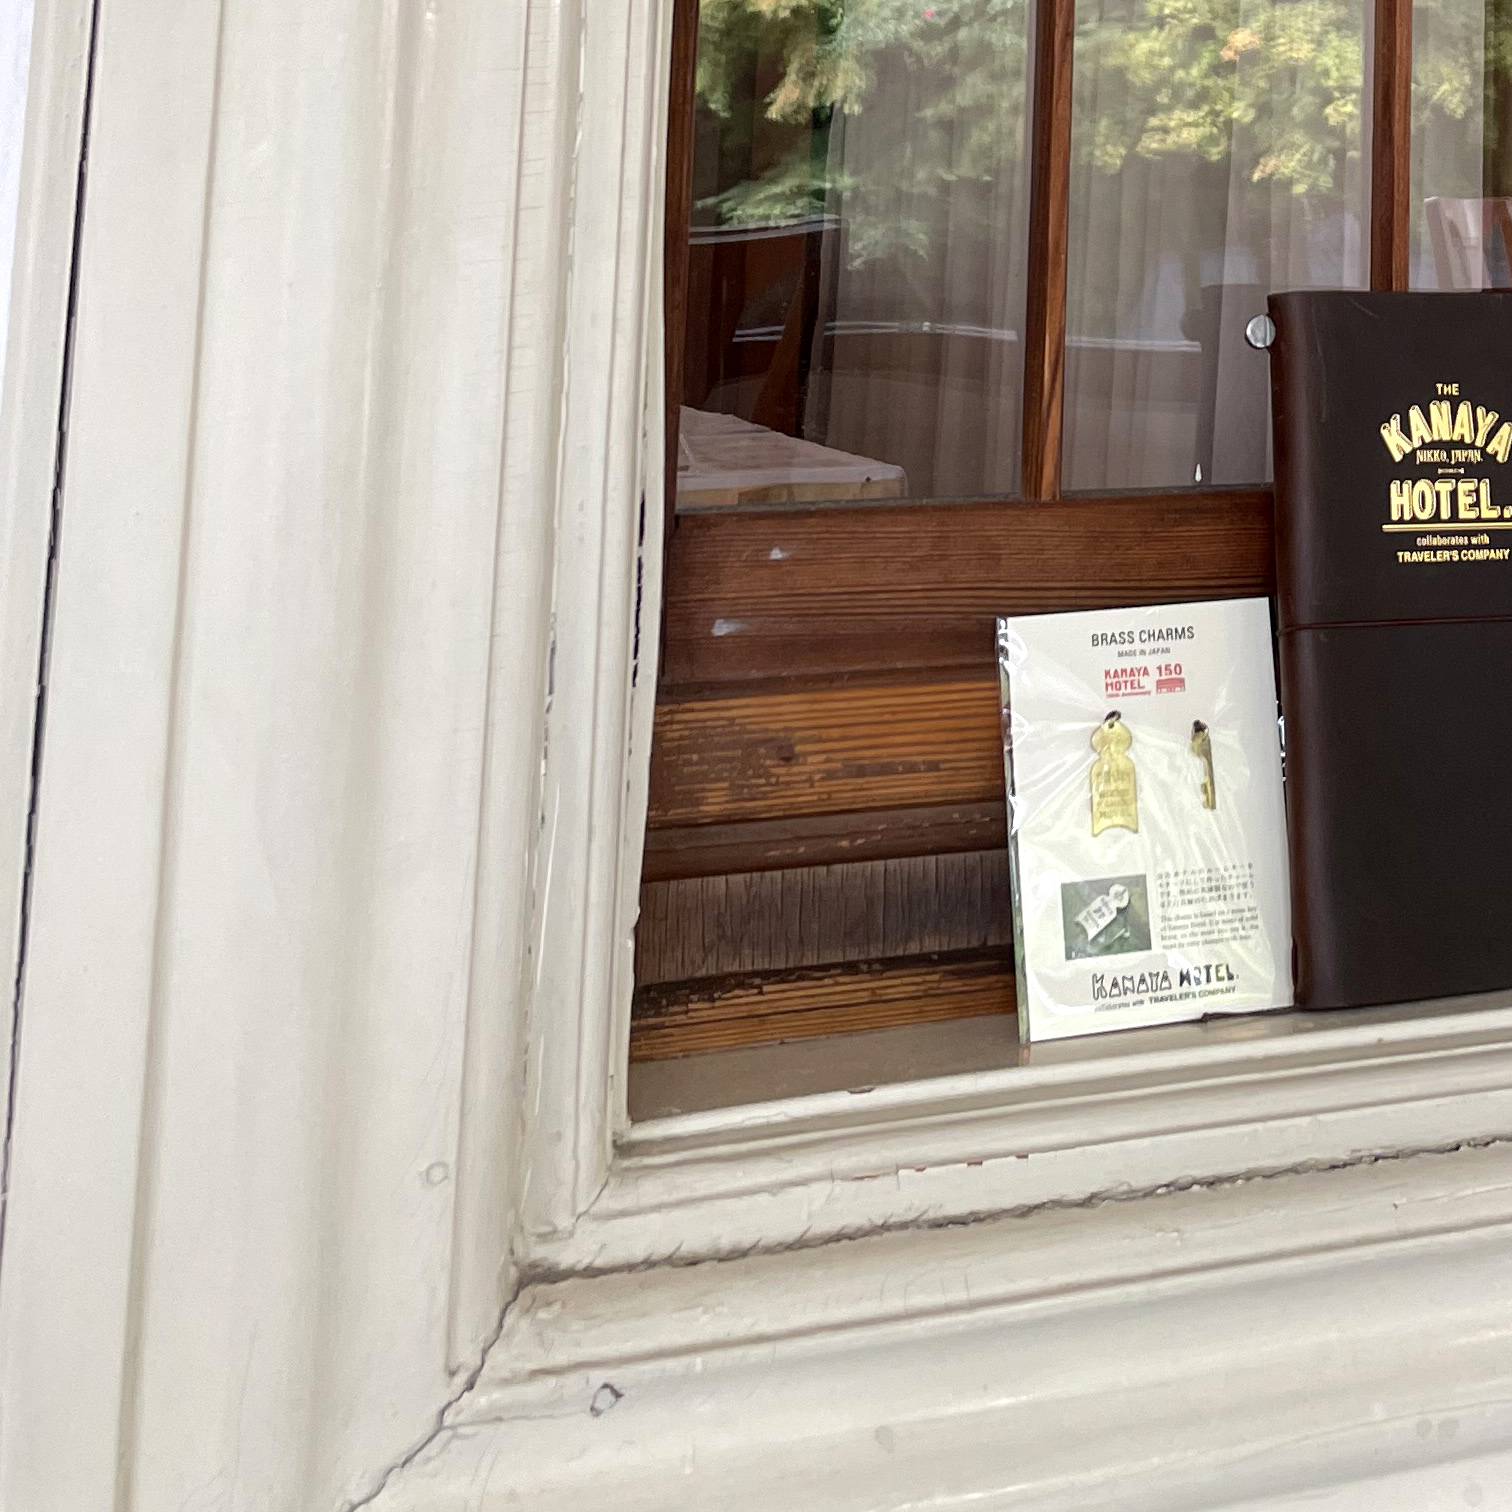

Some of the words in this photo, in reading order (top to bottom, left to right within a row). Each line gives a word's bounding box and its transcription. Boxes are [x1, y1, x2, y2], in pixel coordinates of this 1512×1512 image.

[1436, 383, 1460, 396] THE
[1416, 534, 1468, 547] collaborates
[1470, 533, 1490, 545] with
[1397, 550, 1460, 563] TRAVELER'S
[1461, 548, 1510, 562] COMPANY
[1091, 630, 1135, 647] BRASS
[1139, 626, 1195, 644] CHARMS
[1104, 666, 1150, 680] KANAYA
[1156, 663, 1183, 677] 150
[1105, 679, 1146, 692] HOTEL
[1091, 970, 1173, 1000] KANAYA
[1148, 992, 1197, 1005] TRAVELER'S
[1198, 986, 1236, 999] COMPANY
